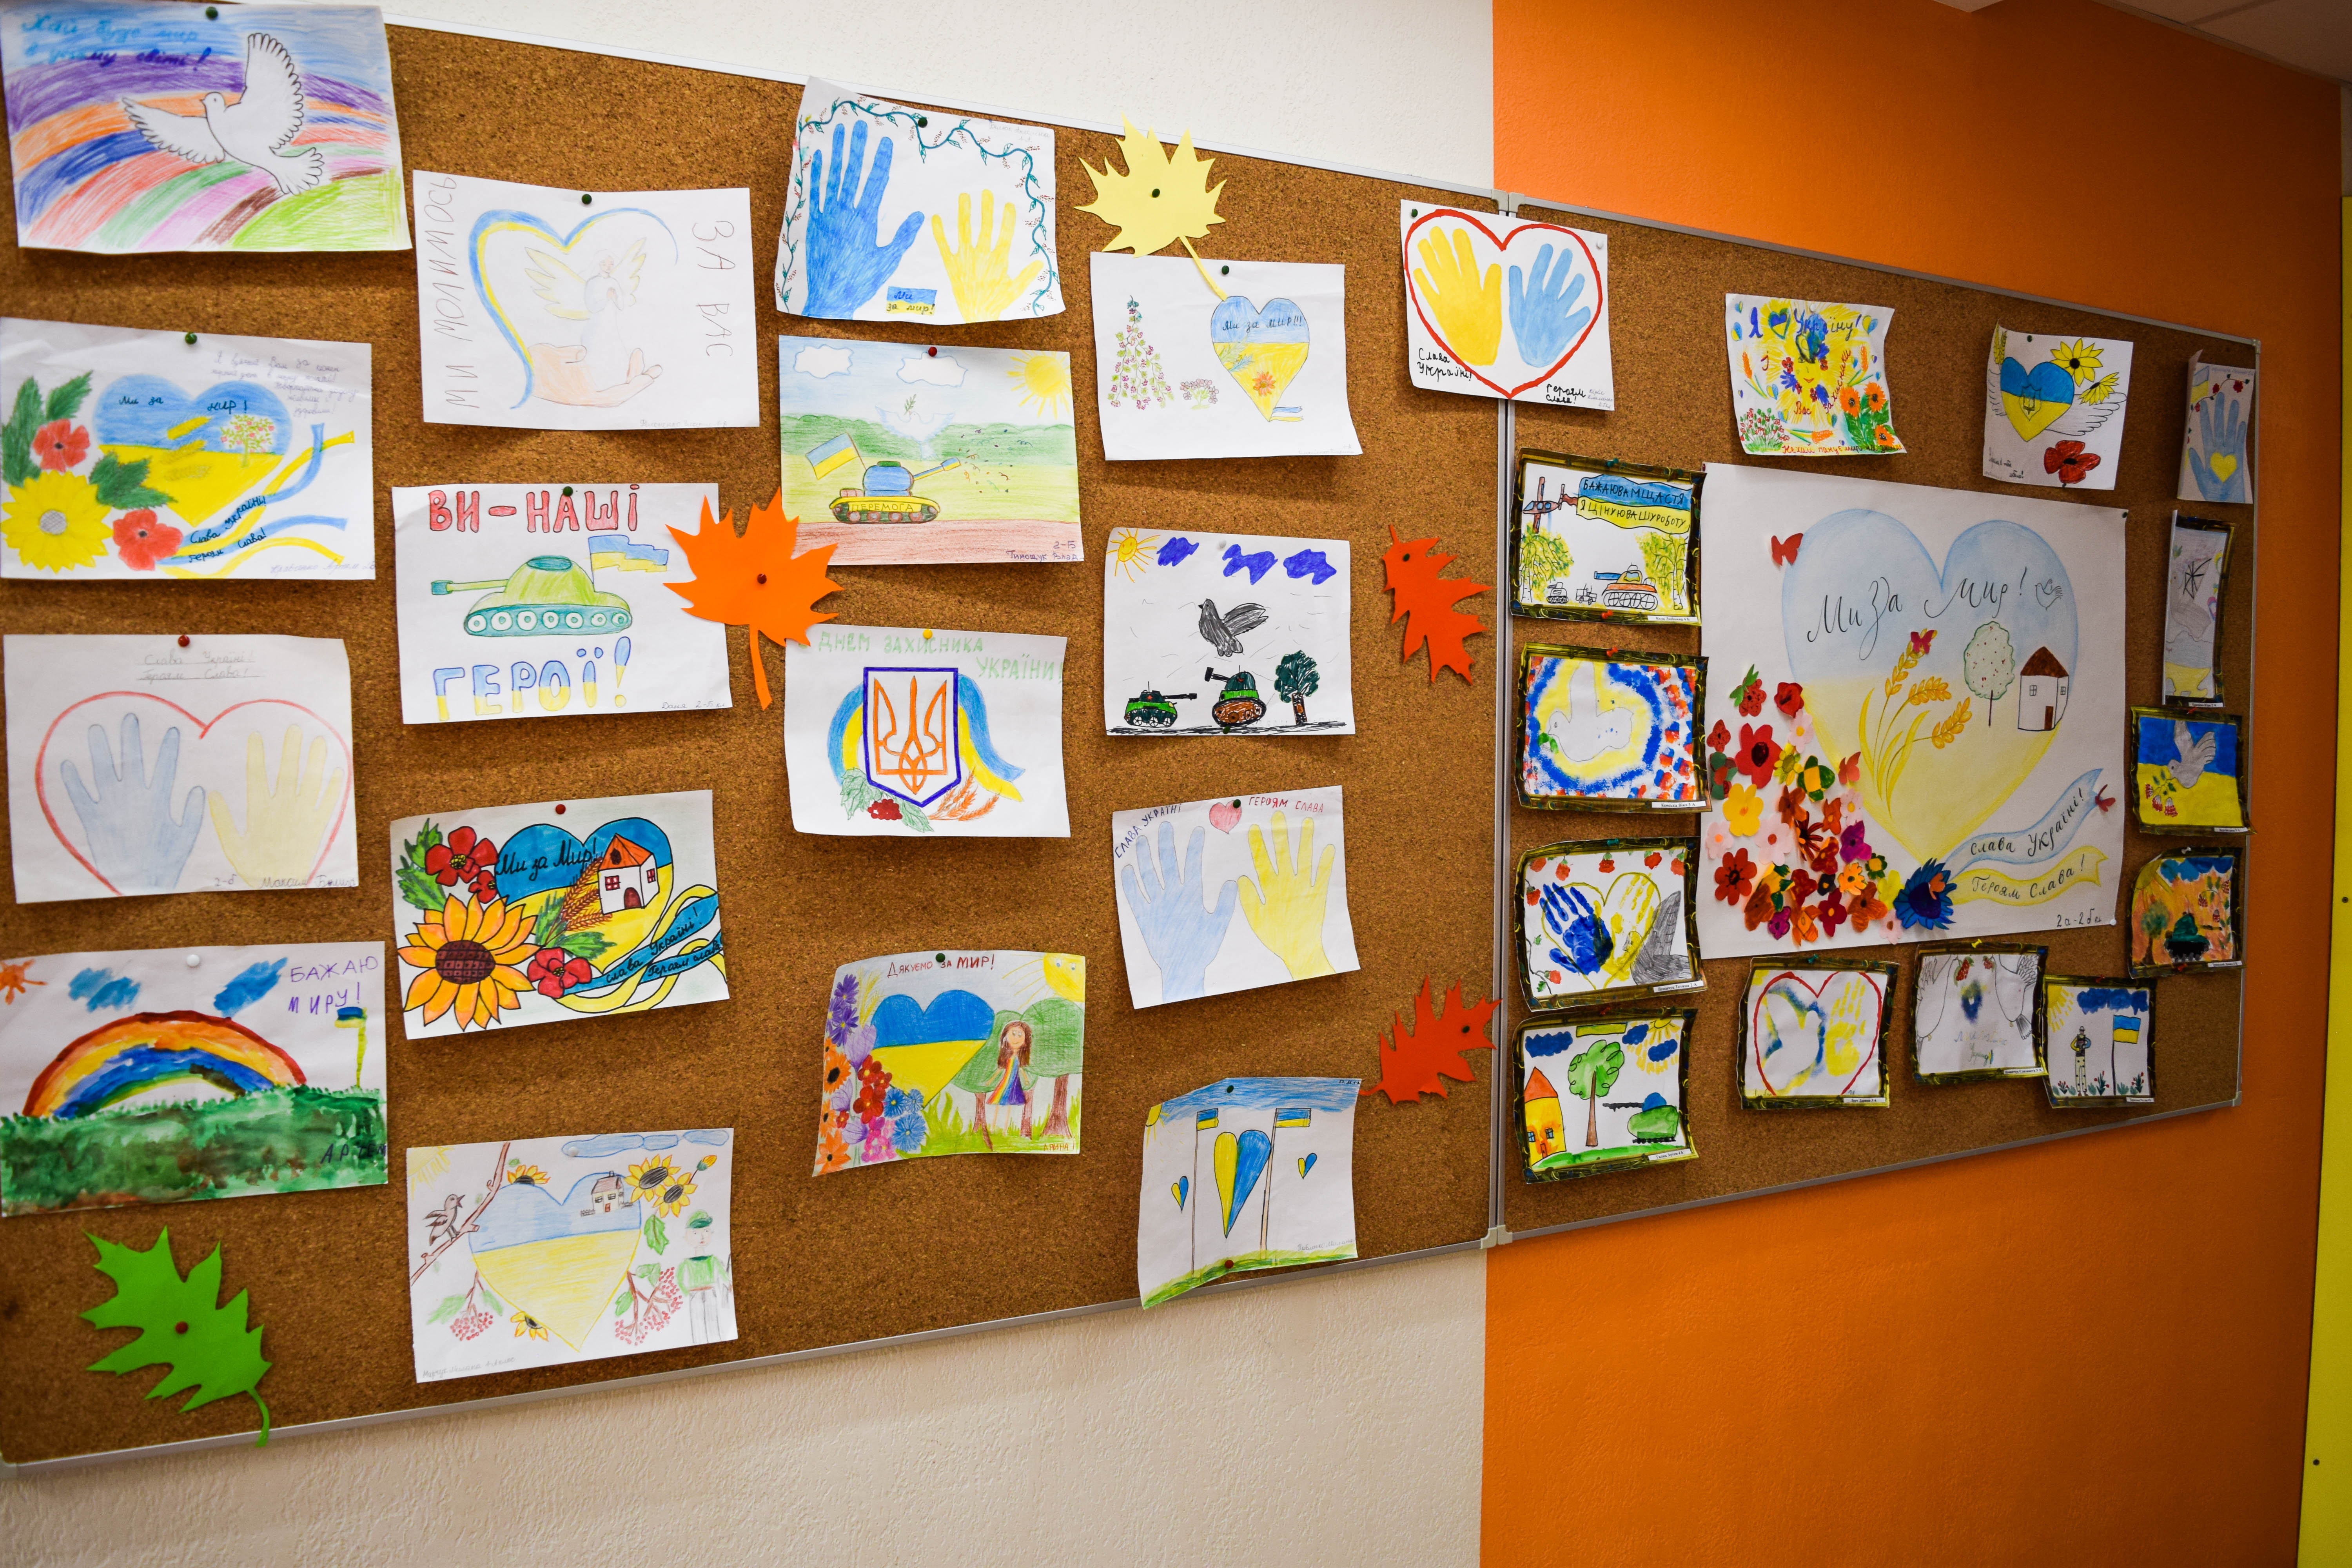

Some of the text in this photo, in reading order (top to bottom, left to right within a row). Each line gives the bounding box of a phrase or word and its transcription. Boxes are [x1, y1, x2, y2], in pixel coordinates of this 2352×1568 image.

[692, 220, 736, 358] ЗА ВАС
[1246, 320, 1260, 334] за
[1749, 307, 1763, 338] Я
[445, 364, 480, 409] МИ
[147, 395, 165, 408] за
[1794, 401, 1812, 415] Вас
[817, 631, 984, 655] ДНЕМ ЗАХИСНИКА
[1248, 796, 1324, 813] ГЕРОЯМ СЛАВА
[1114, 802, 1181, 859] СЛАВА УКРАЇНІ
[528, 853, 549, 882] за
[289, 956, 379, 983] БАЖАЮ
